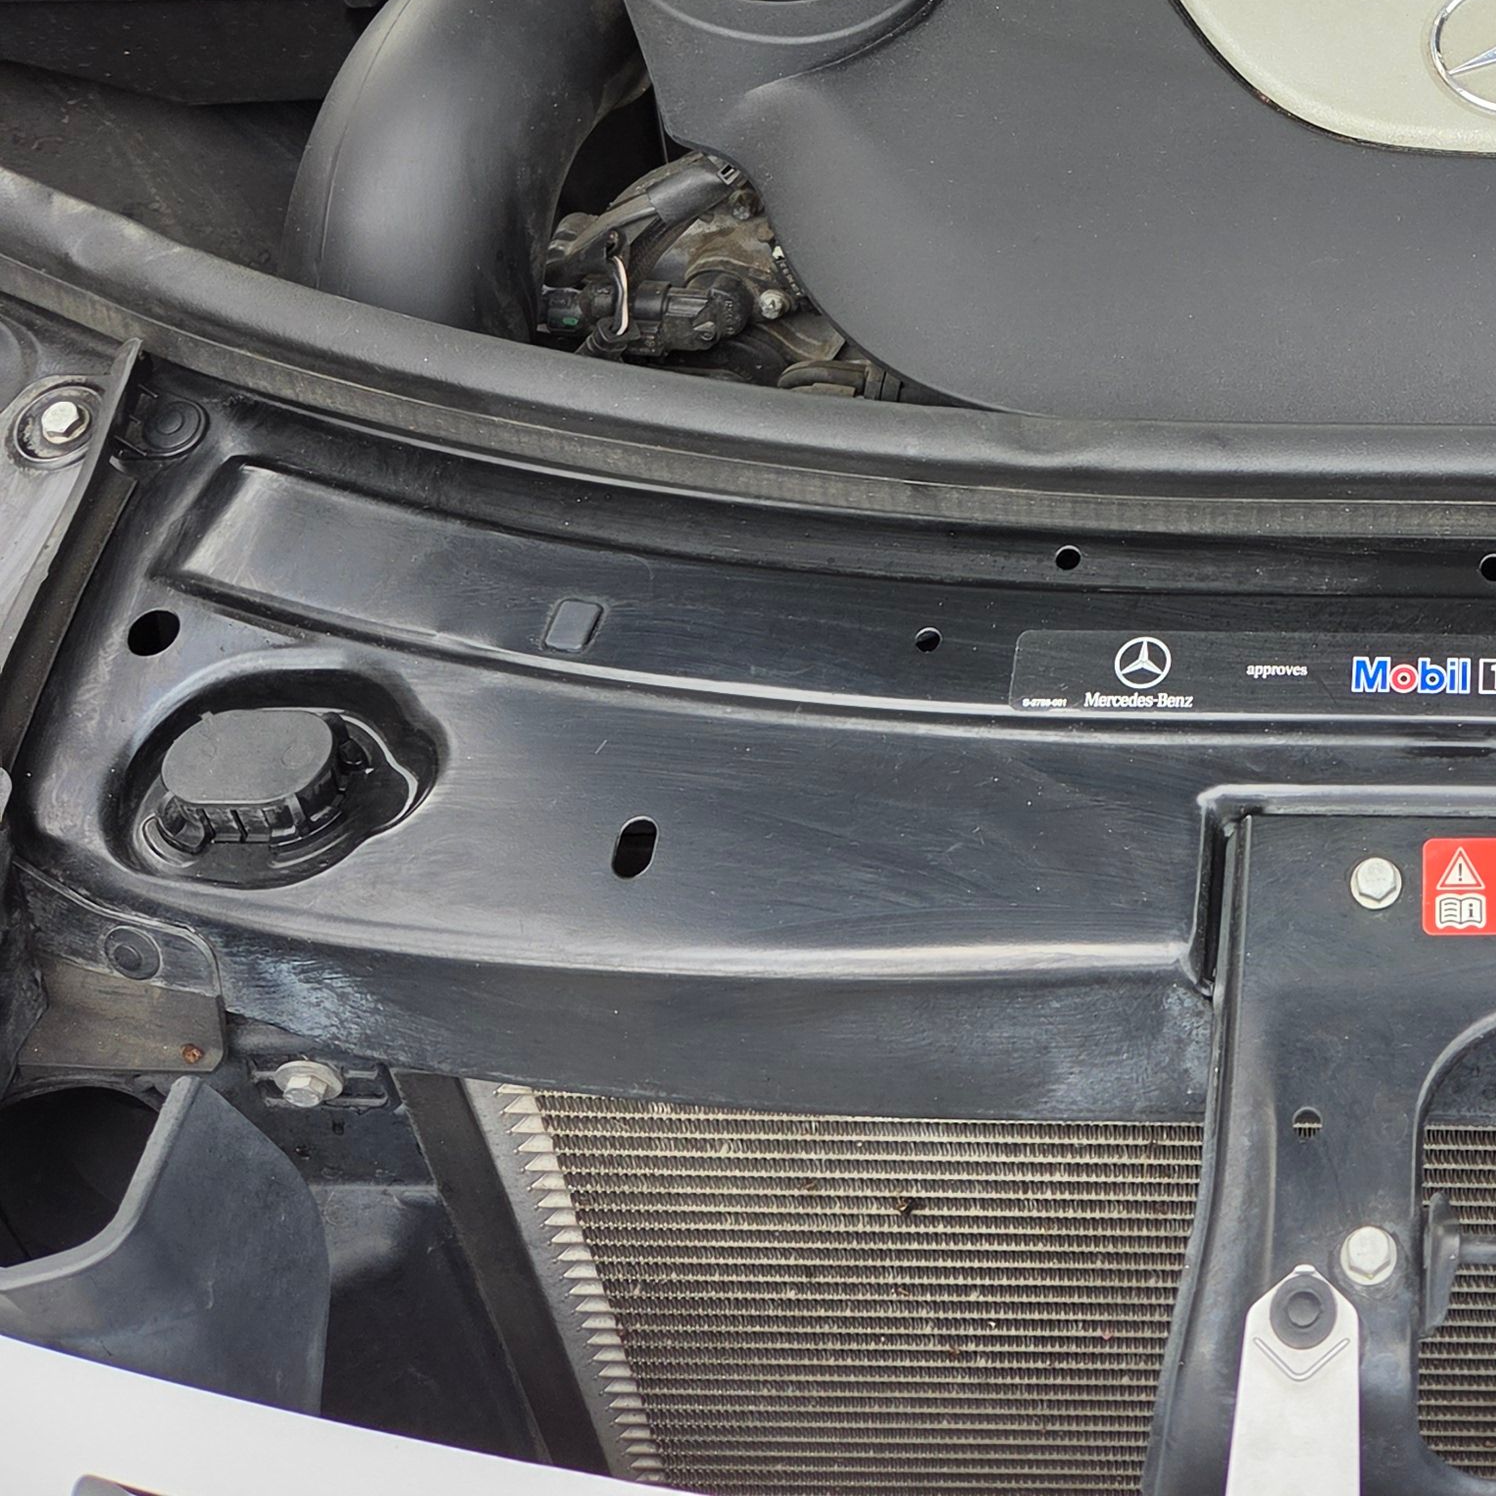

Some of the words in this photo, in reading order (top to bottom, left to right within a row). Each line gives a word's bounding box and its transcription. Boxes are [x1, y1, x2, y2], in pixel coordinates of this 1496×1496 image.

[1246, 663, 1308, 679] approves
[1351, 656, 1472, 694] Mobil
[1083, 691, 1194, 708] Mercedes-Benz
